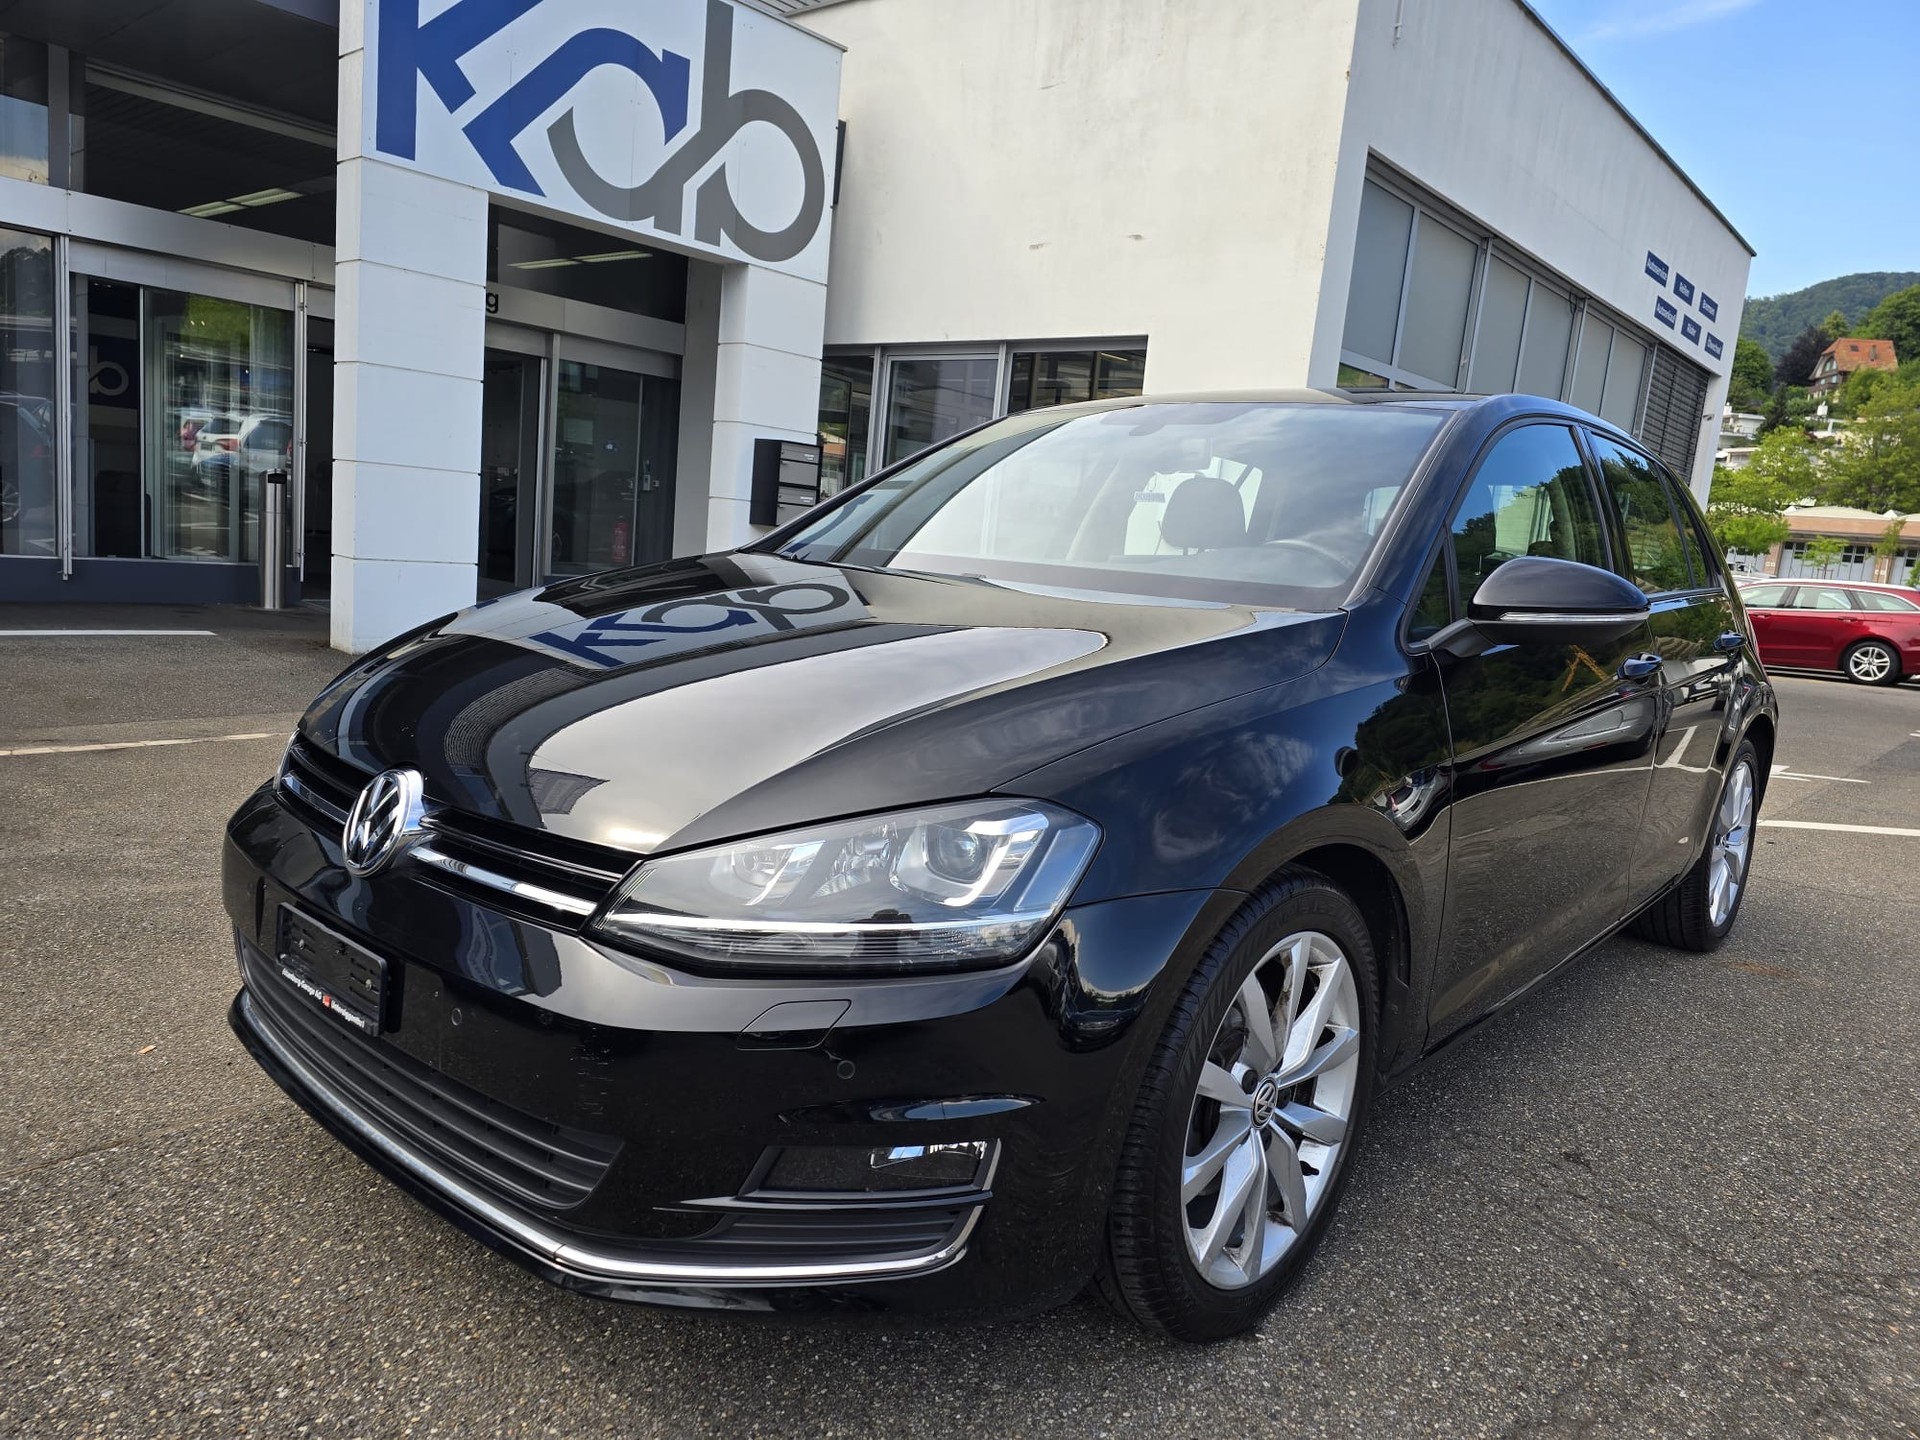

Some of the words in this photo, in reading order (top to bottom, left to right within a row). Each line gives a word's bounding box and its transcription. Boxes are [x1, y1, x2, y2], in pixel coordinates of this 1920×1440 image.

[1647, 257, 1668, 281] Autoservice
[1680, 282, 1690, 297] Reifen
[1657, 302, 1677, 324] Autoankauf
[1702, 299, 1715, 315] Bremsen
[315, 989, 322, 1000] AG
[331, 1000, 365, 1028] Untersiggenthal
